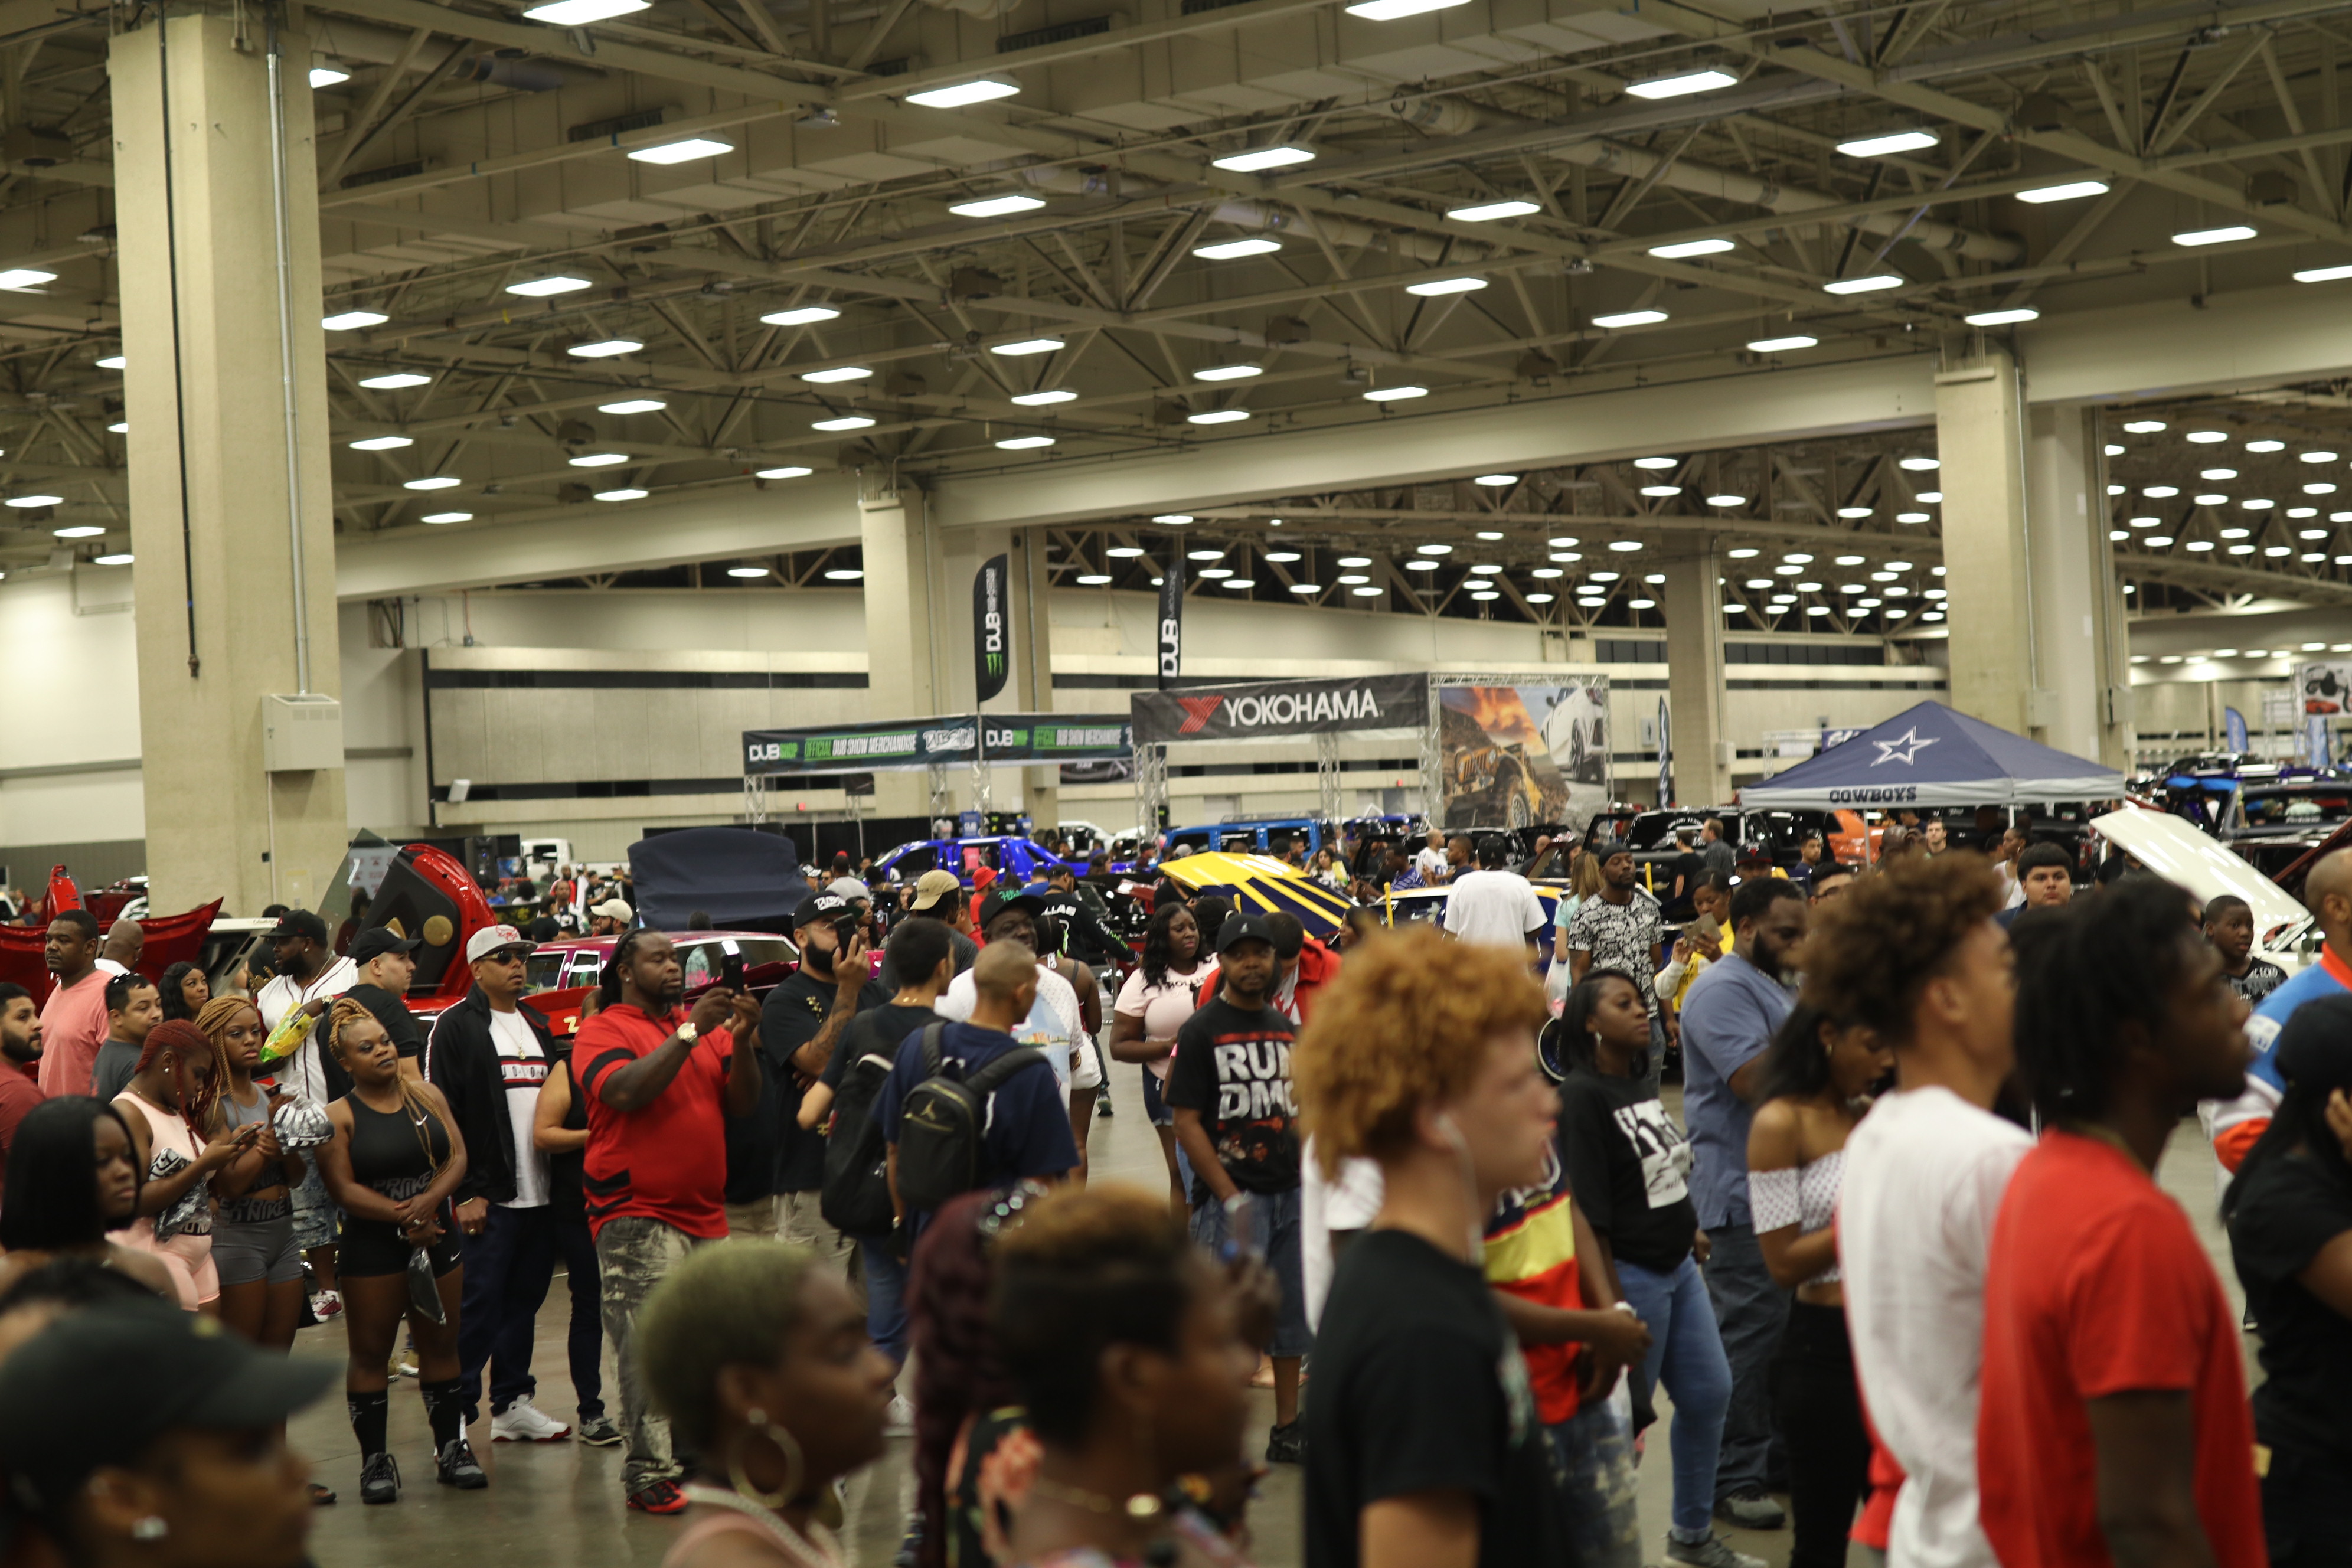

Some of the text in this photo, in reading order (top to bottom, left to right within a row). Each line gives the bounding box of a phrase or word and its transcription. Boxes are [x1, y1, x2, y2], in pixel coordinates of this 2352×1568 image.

[986, 612, 1002, 652] DUB
[1161, 619, 1179, 678] DUB
[1224, 688, 1379, 727] YOKOHAMA
[804, 734, 917, 757] OFFICIAL DUB SHOW MERCHANDISE
[1830, 786, 1917, 803] COWBOYS
[1041, 904, 1077, 917] LLAS
[1218, 1079, 1299, 1120] DMC
[247, 1200, 285, 1221] NIKE
